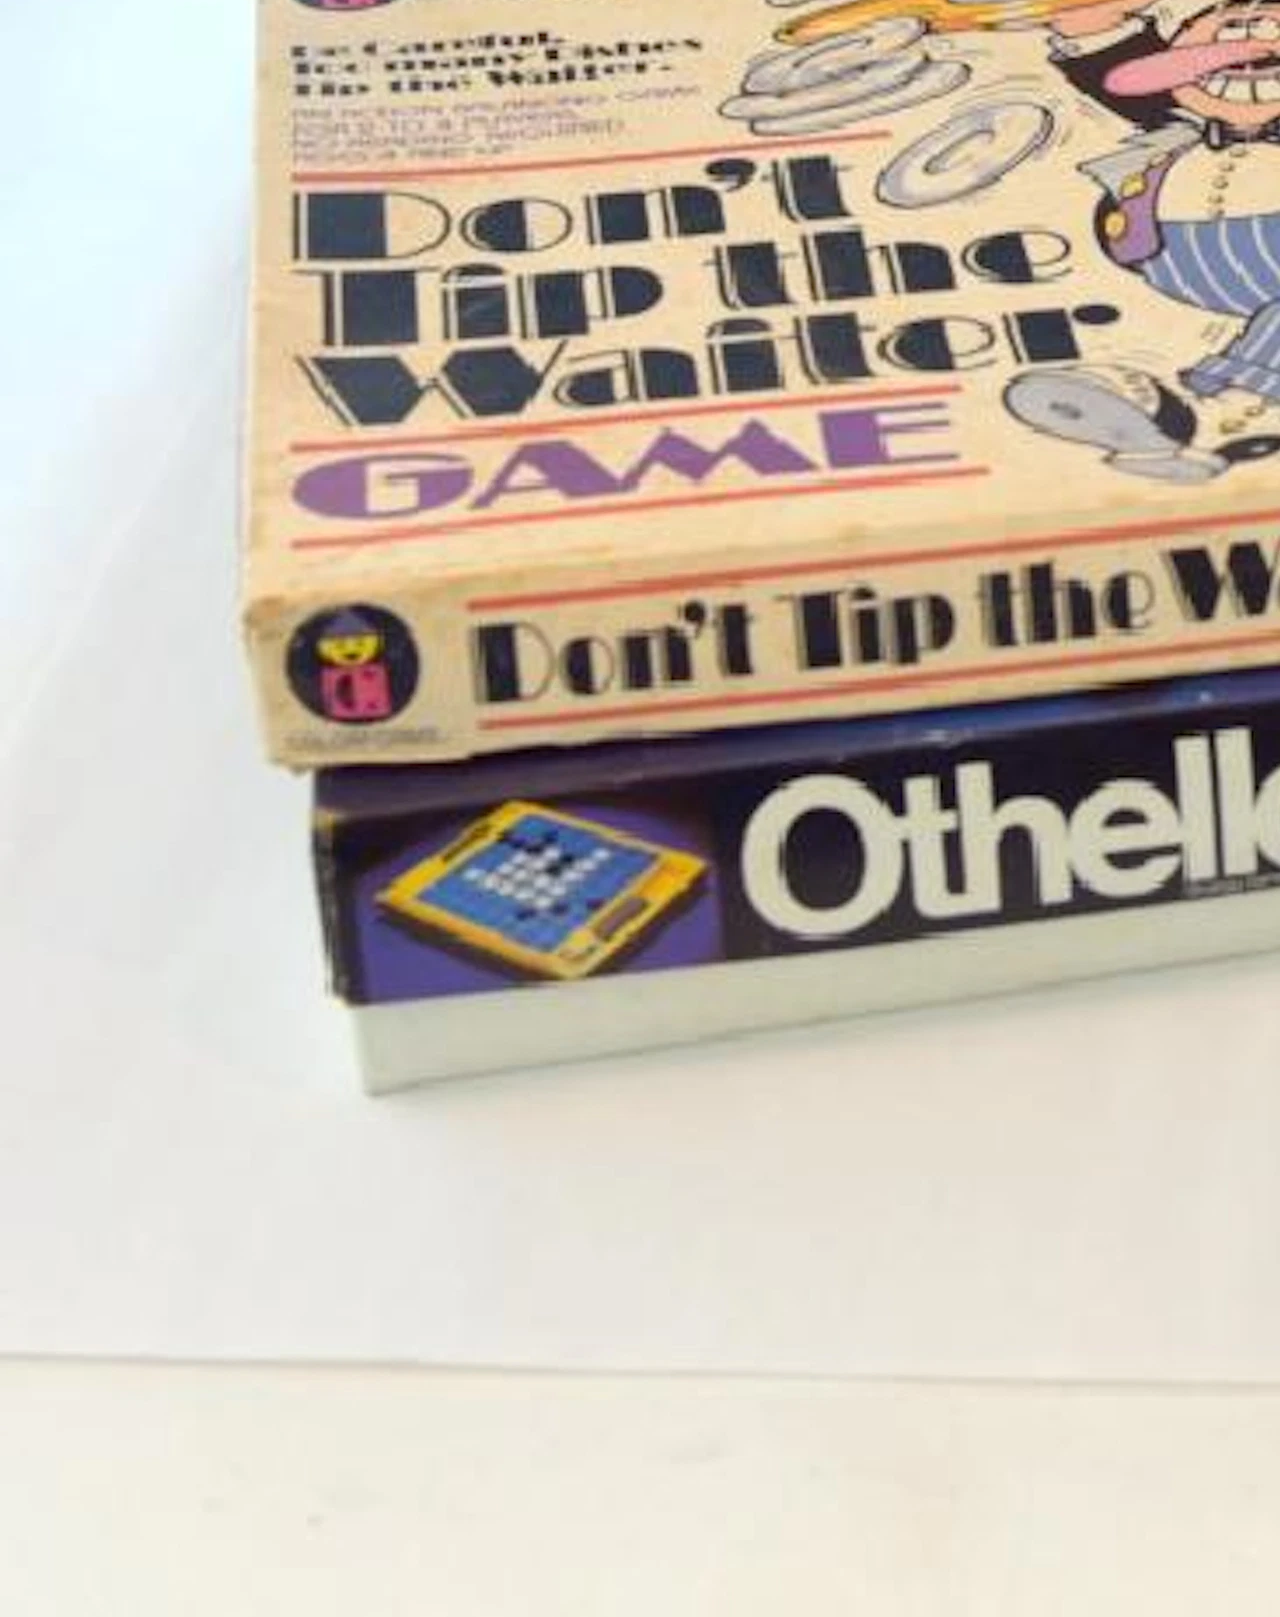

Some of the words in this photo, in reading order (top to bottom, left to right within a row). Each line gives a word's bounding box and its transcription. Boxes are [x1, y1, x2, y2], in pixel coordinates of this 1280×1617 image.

[292, 153, 852, 262] Don't
[293, 262, 664, 347] Tip
[710, 225, 1074, 312] the
[295, 302, 1123, 429] Waiter
[291, 401, 962, 521] GAME
[470, 598, 757, 706] Don't
[776, 584, 956, 670] Tip
[978, 560, 1157, 648] the
